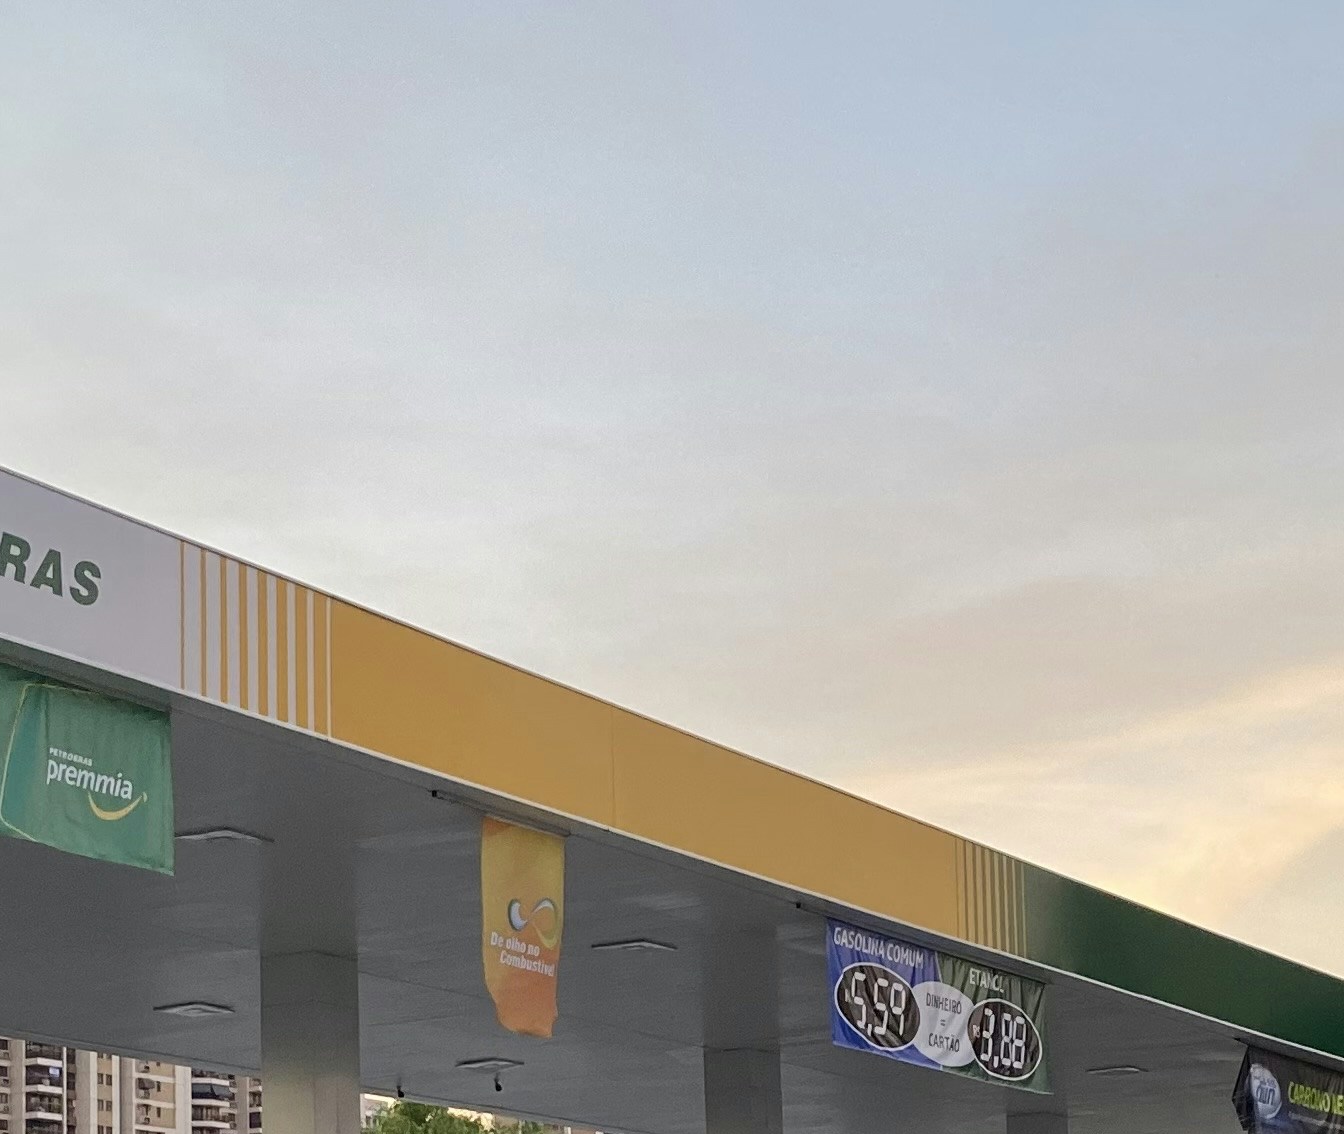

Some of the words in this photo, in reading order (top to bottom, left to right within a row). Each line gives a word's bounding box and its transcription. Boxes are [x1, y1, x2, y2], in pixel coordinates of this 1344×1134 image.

[46, 759, 133, 800] premmia
[490, 931, 504, 948] De
[528, 944, 540, 957] no
[834, 927, 884, 959] GASOLINA
[887, 943, 924, 969] COMUM
[926, 992, 962, 1015] DINHEIRO
[928, 1032, 960, 1053] CARTÃO
[1288, 1081, 1331, 1113] CARBONO
